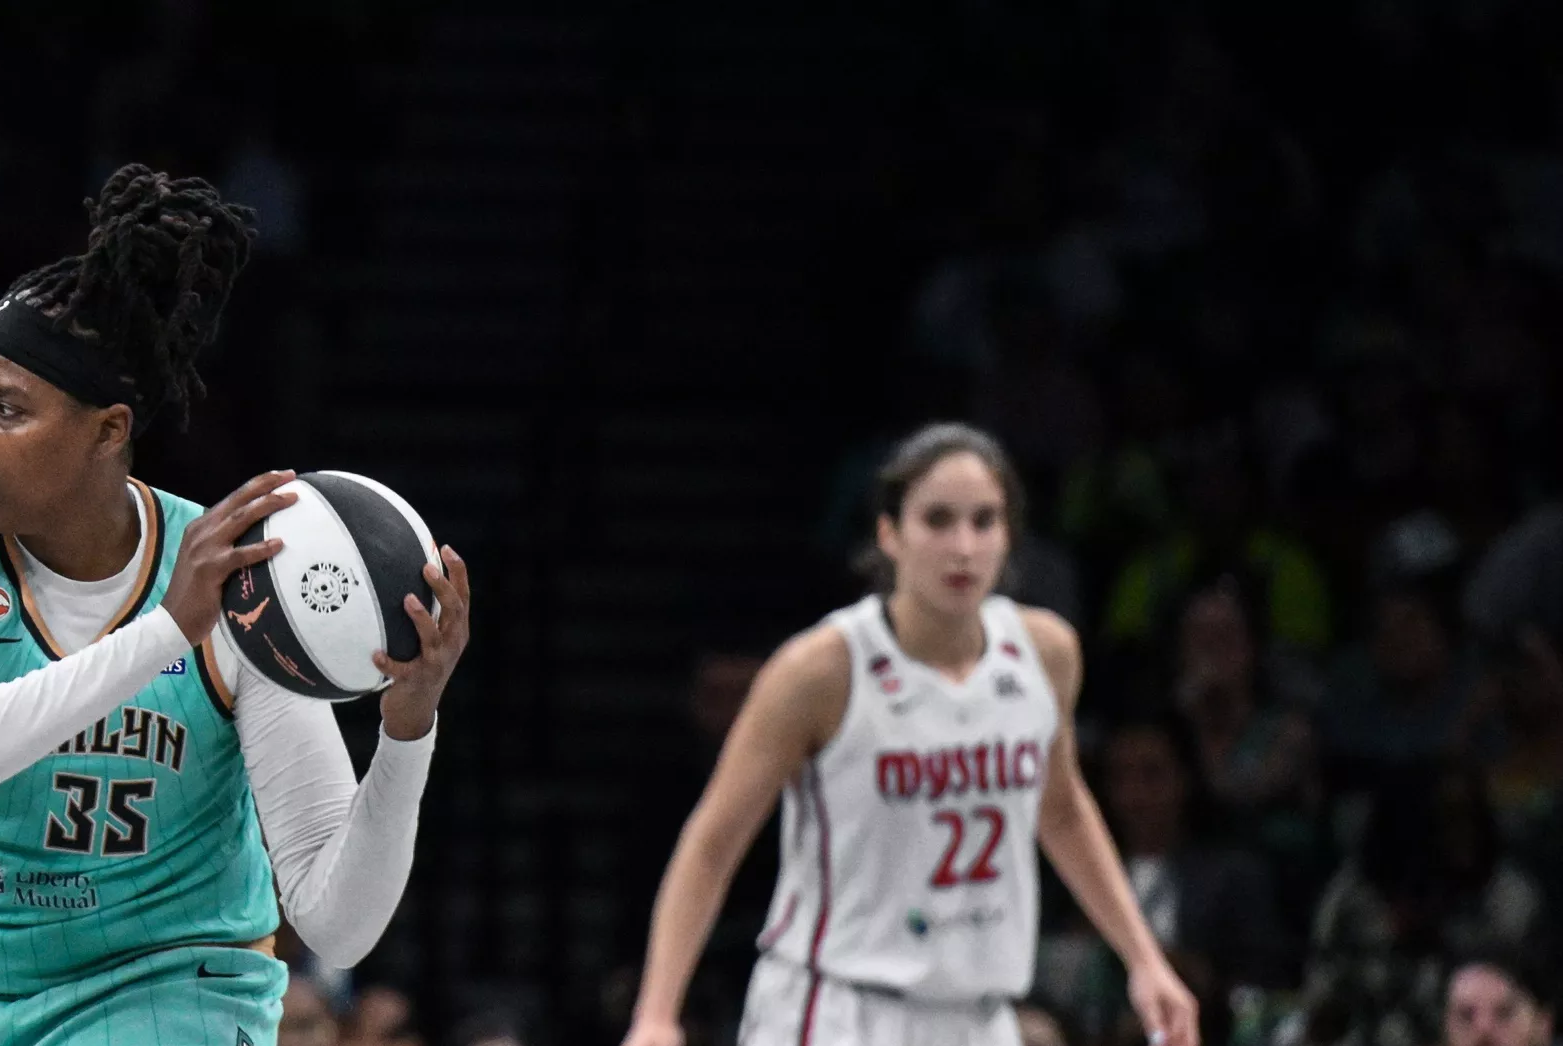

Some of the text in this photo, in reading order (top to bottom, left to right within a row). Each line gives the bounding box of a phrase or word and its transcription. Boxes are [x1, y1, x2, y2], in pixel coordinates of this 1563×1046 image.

[50, 707, 187, 773] LYN
[44, 772, 156, 857] 35
[930, 805, 1005, 889] 22
[13, 886, 97, 908] Mutual
